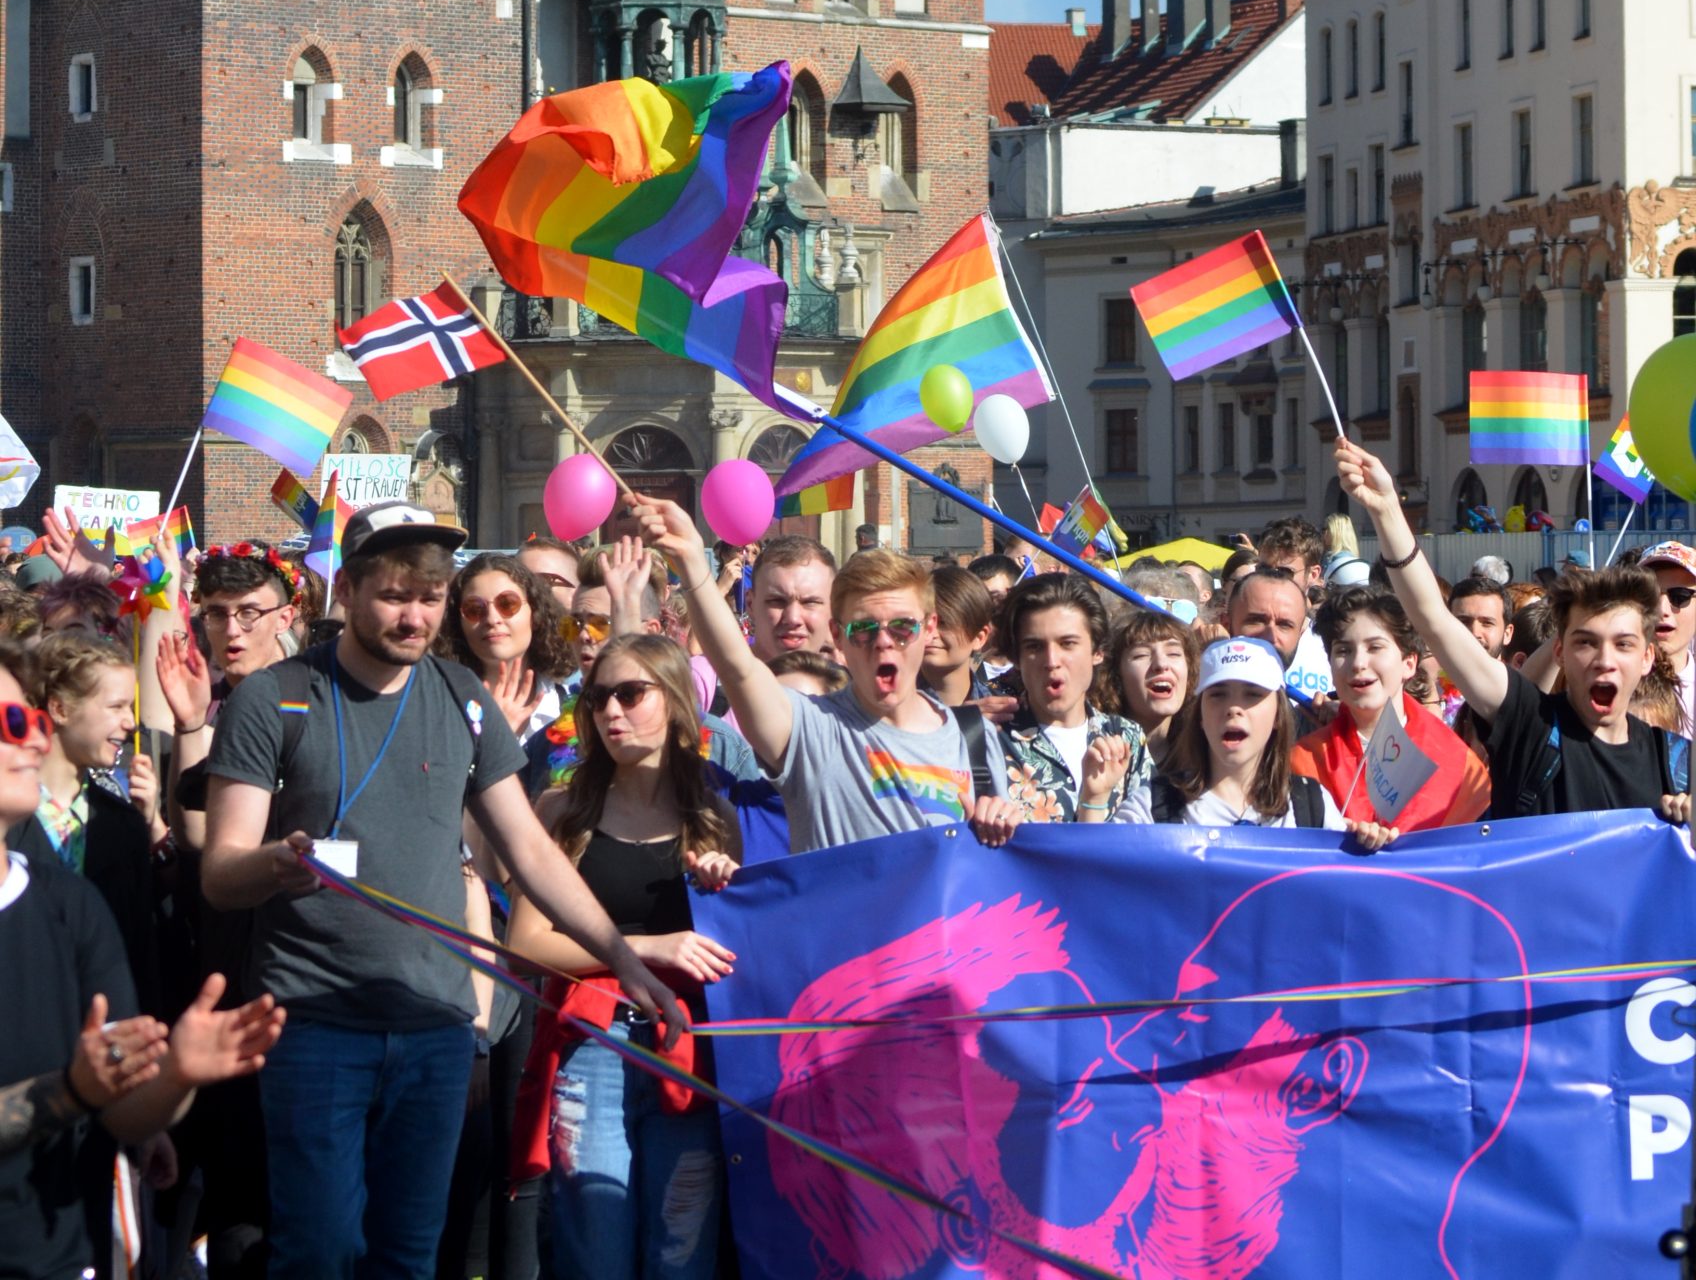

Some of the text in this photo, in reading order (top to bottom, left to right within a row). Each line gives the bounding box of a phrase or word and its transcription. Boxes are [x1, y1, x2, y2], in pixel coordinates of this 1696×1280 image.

[68, 492, 140, 511] TECHNO
[1221, 654, 1252, 665] PUSSY
[1629, 1094, 1692, 1180] P
